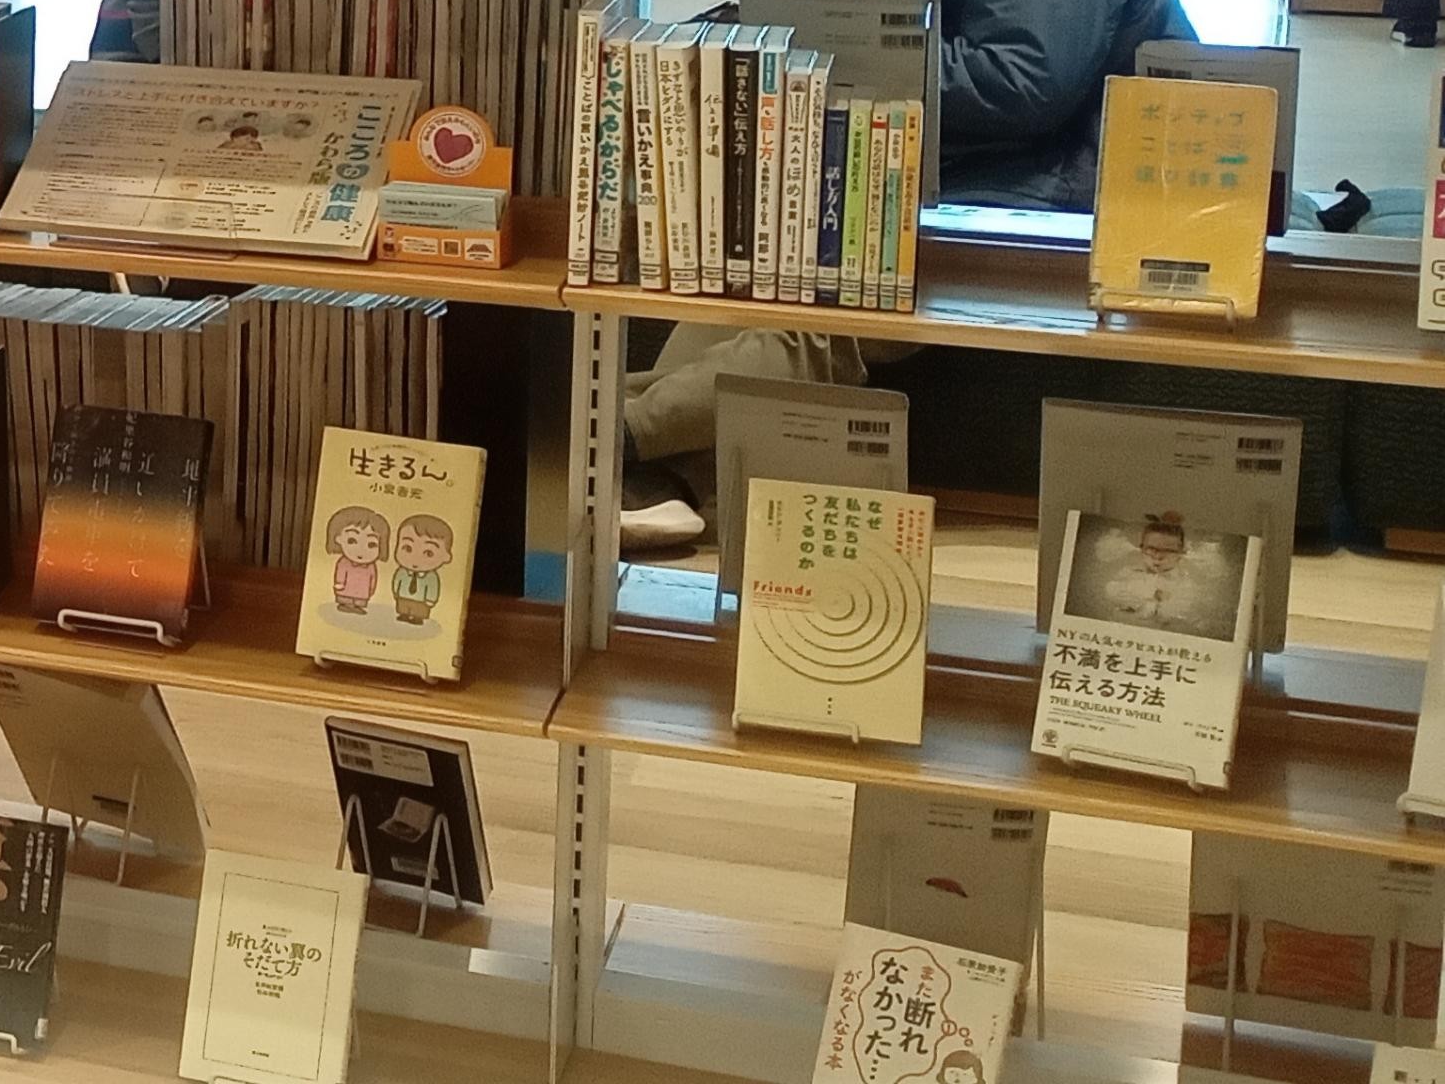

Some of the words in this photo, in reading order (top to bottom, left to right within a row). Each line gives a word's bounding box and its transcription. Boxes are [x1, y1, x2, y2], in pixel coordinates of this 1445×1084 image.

[659, 60, 677, 148] 日本をダメにする
[318, 104, 384, 224] こころの健康
[798, 493, 818, 570] つくるのか
[822, 496, 841, 558] 友だちを
[843, 497, 862, 561] 私たちは
[866, 500, 883, 530] なぜ
[753, 580, 812, 597] Friends
[1048, 670, 1167, 709] 伝える方法
[1052, 642, 1198, 685] 不満を上手に
[1049, 695, 1072, 707] THE
[1072, 698, 1124, 717] SQUEAKY
[1124, 707, 1163, 724] WHEEL
[242, 951, 303, 978] そだて方
[823, 968, 863, 1071] がなくなる本
